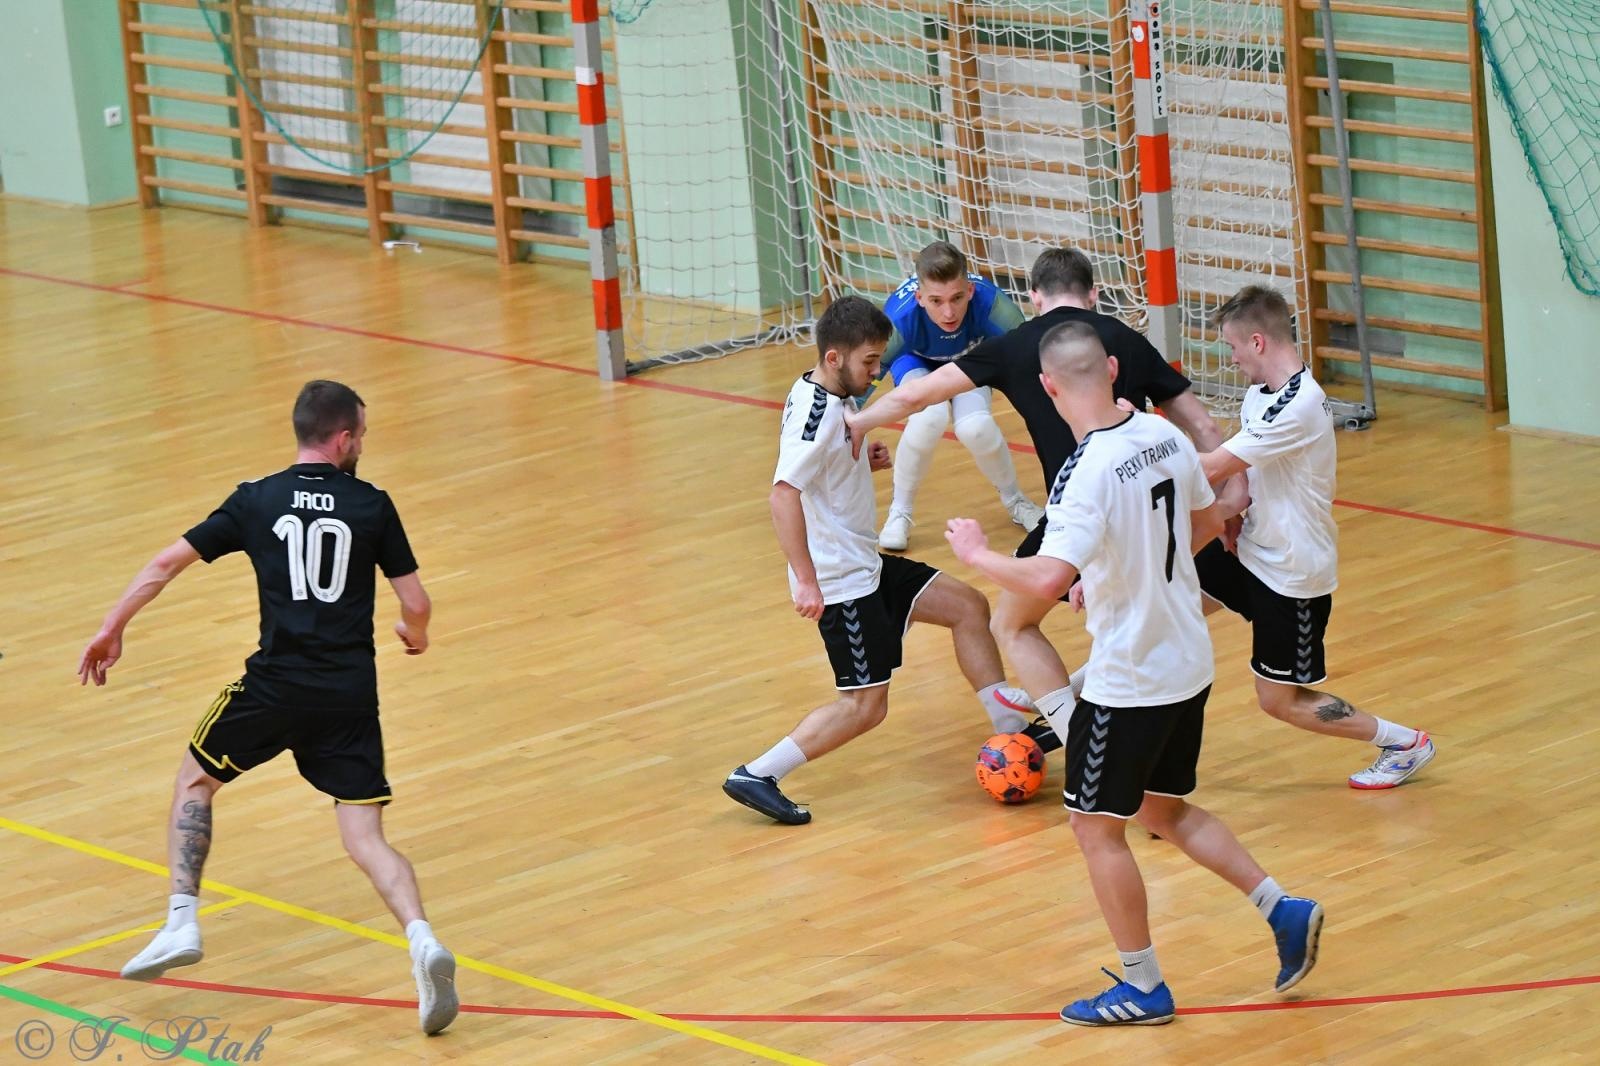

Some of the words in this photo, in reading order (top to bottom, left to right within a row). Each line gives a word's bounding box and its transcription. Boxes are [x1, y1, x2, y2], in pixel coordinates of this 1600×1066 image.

[290, 490, 335, 512] JACO
[1151, 478, 1177, 583] 7
[272, 514, 353, 603] 10
